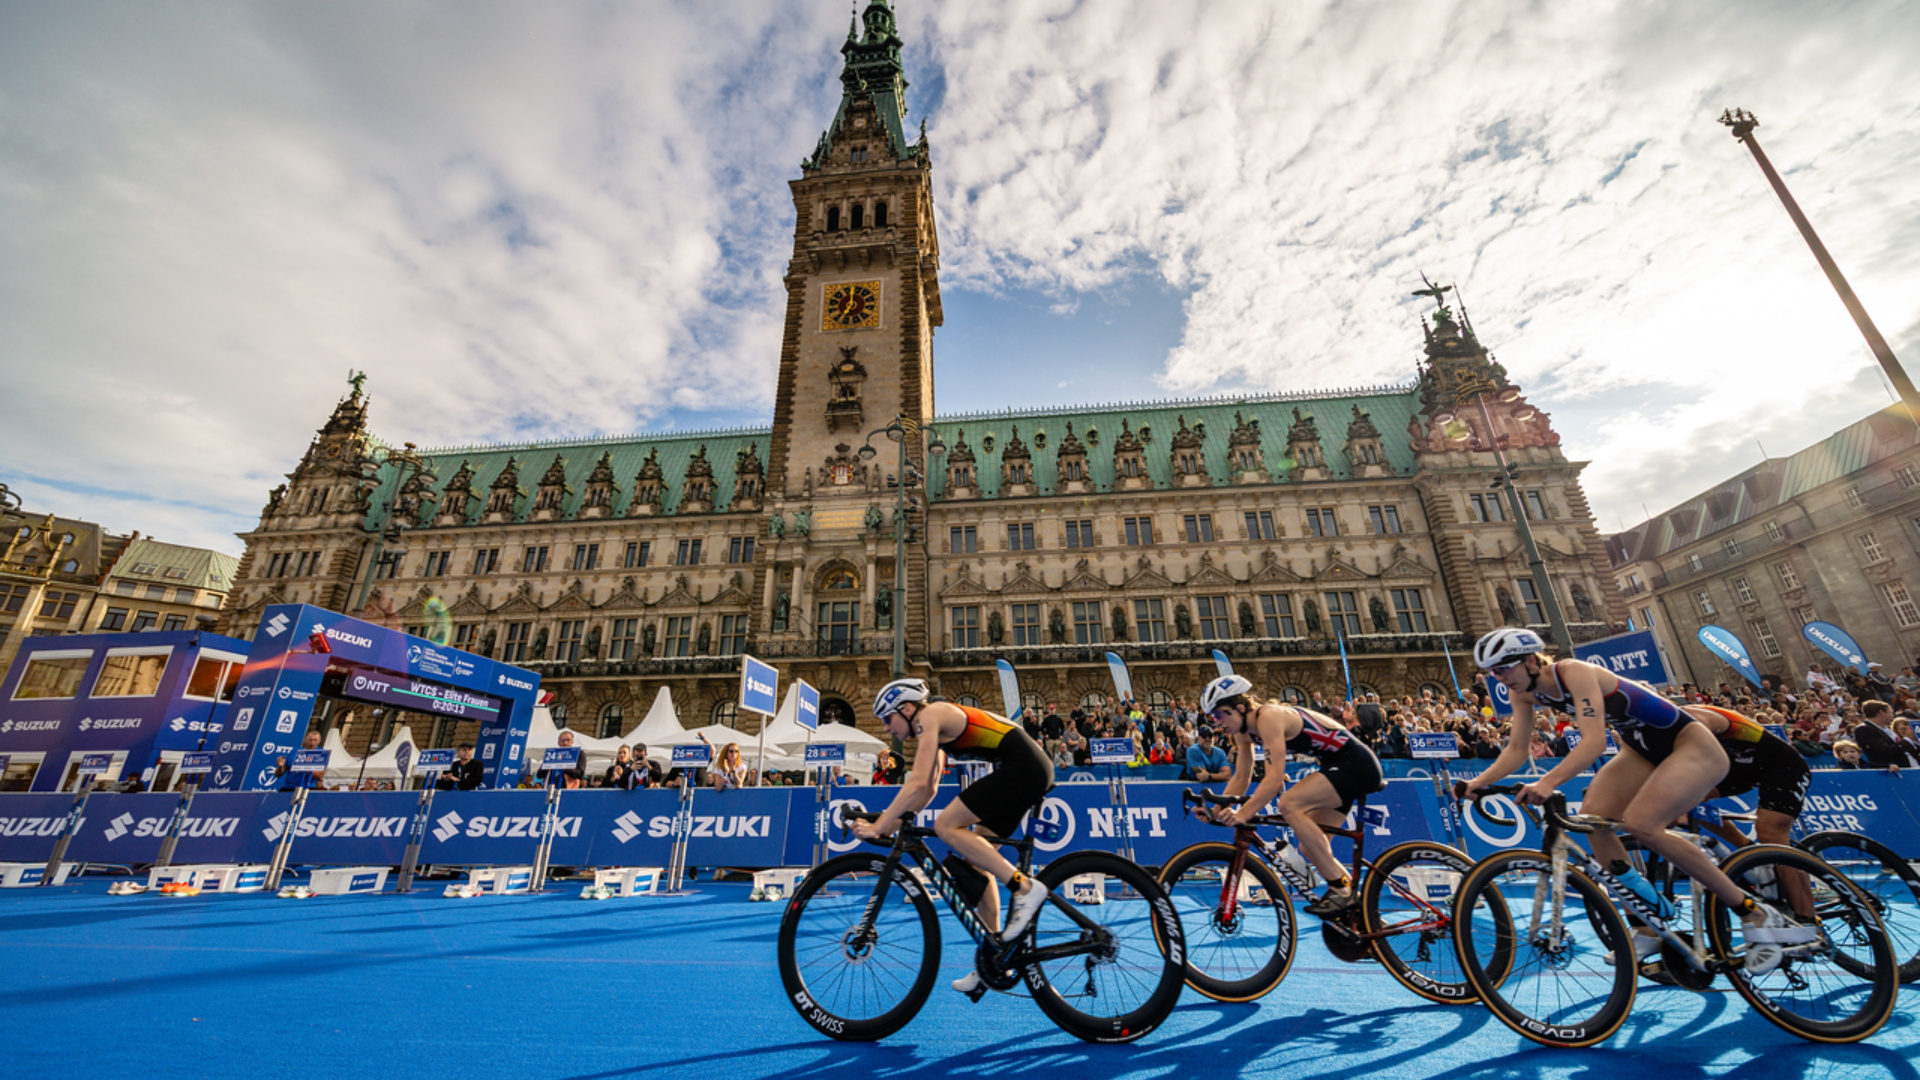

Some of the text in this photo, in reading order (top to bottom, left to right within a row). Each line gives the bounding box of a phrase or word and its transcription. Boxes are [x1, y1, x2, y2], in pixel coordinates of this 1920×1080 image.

[326, 629, 373, 648] SUZUKI
[1609, 650, 1649, 672] NTT
[367, 680, 390, 693] NTT
[506, 677, 534, 691] SUZUKI
[410, 682, 438, 697] WTCS
[444, 690, 463, 702] Elite
[463, 694, 489, 708] Frauen
[432, 700, 466, 714] 0:20:13
[14, 720, 61, 731] SUZUKI
[93, 718, 142, 730] SUZUKI
[1093, 743, 1105, 754] 32
[1411, 737, 1426, 748] 36
[420, 753, 431, 763] 22
[545, 751, 556, 761] 24
[674, 749, 685, 758] 26
[807, 749, 819, 758] 28
[1803, 794, 1879, 812] MBURG
[133, 817, 241, 837] SUZUKI
[295, 817, 408, 837] SUZUKI
[465, 816, 583, 838] SUZUKI
[1087, 807, 1168, 838] NTT
[1806, 814, 1866, 831] SSER
[1258, 846, 1320, 904] S-WORK
[1507, 859, 1552, 873] rov
[1274, 898, 1293, 961] roval
[1169, 943, 1183, 966] DT
[1025, 962, 1044, 991] WISS
[1403, 970, 1466, 997] roval
[794, 991, 846, 1034] DT SWISS
[1519, 1017, 1587, 1040] roval
